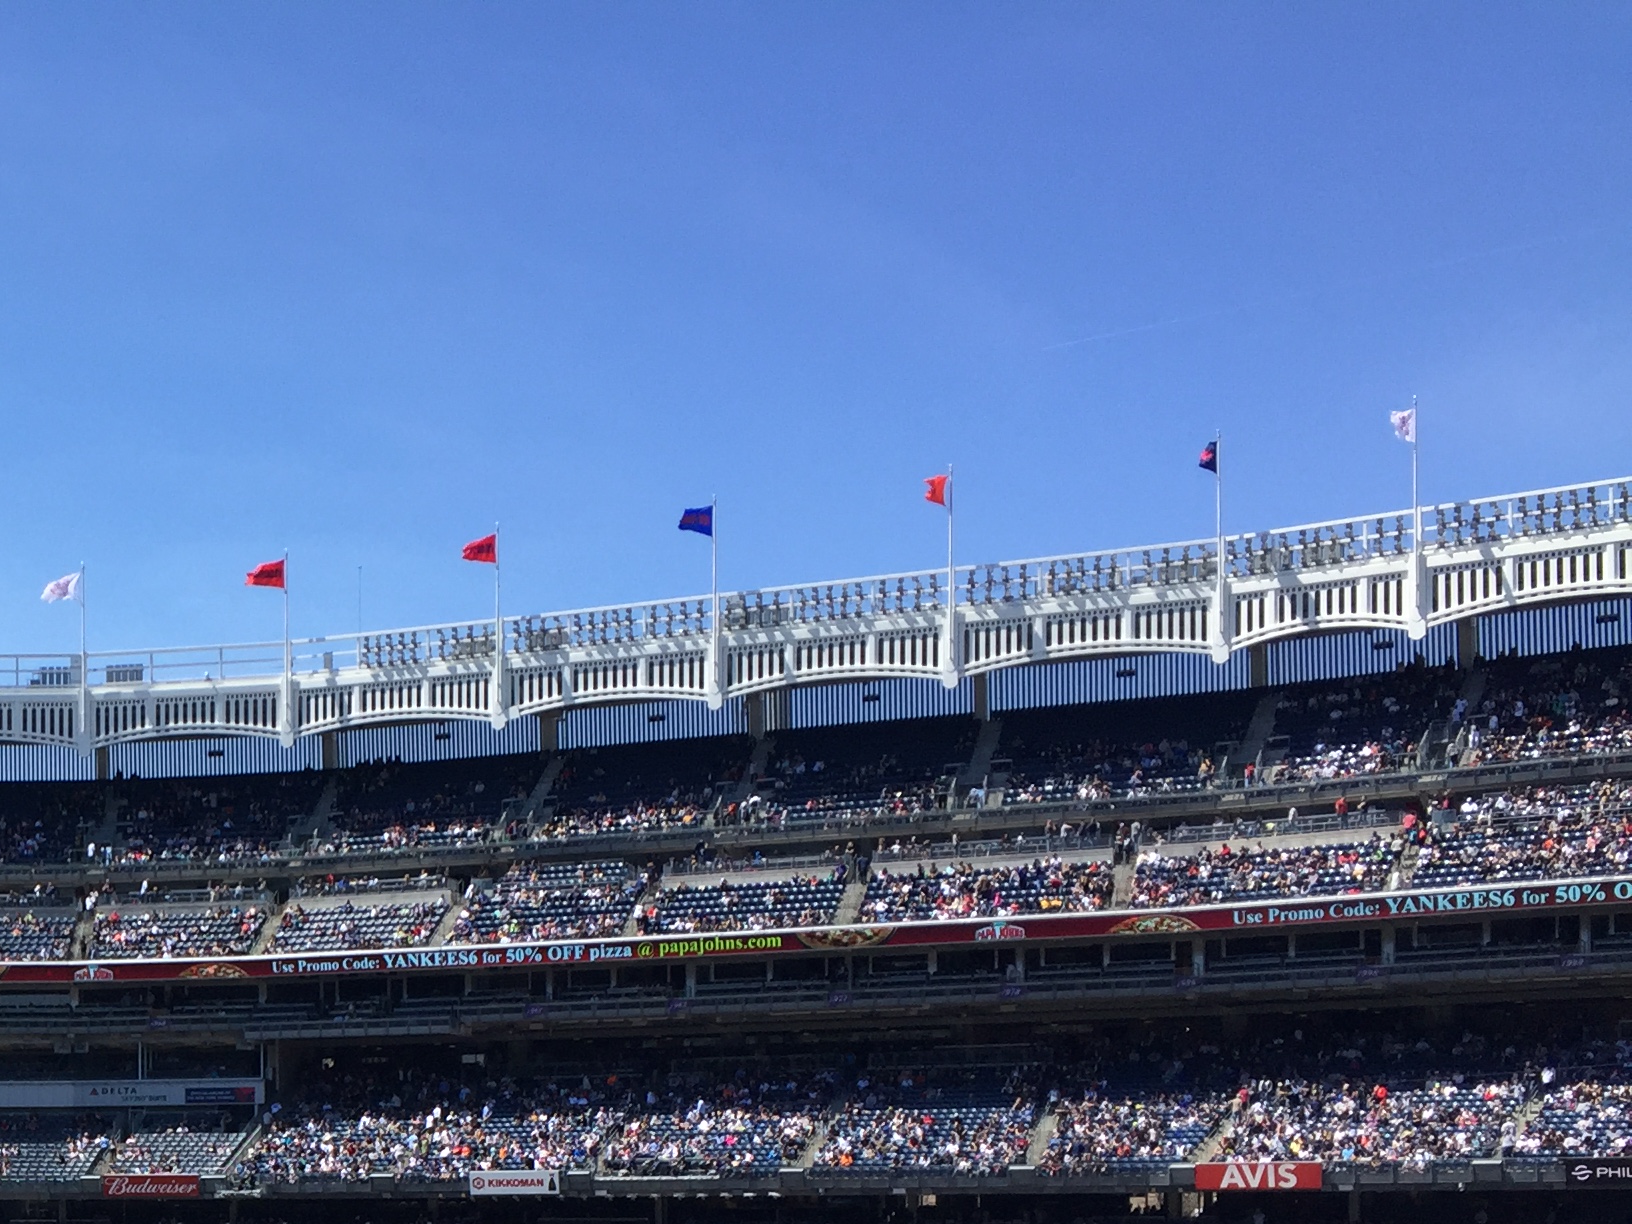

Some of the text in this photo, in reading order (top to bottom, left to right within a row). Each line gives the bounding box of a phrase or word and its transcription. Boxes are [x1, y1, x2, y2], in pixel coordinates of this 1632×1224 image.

[1233, 909, 1263, 926] Use
[1268, 906, 1325, 923] Promo
[1329, 902, 1380, 919] Code:
[1385, 889, 1515, 915] YANKEES6
[1521, 889, 1549, 906] for
[1555, 883, 1606, 903] 50%
[272, 936, 782, 974] Use Promo Code: YANKEES6 for 50% OFF pizza @ papajohns.com
[101, 1087, 138, 1095] DELTA
[104, 1177, 199, 1195] Budweiser
[488, 1178, 544, 1187] KIKKOMAN
[1219, 1163, 1298, 1189] AVIS
